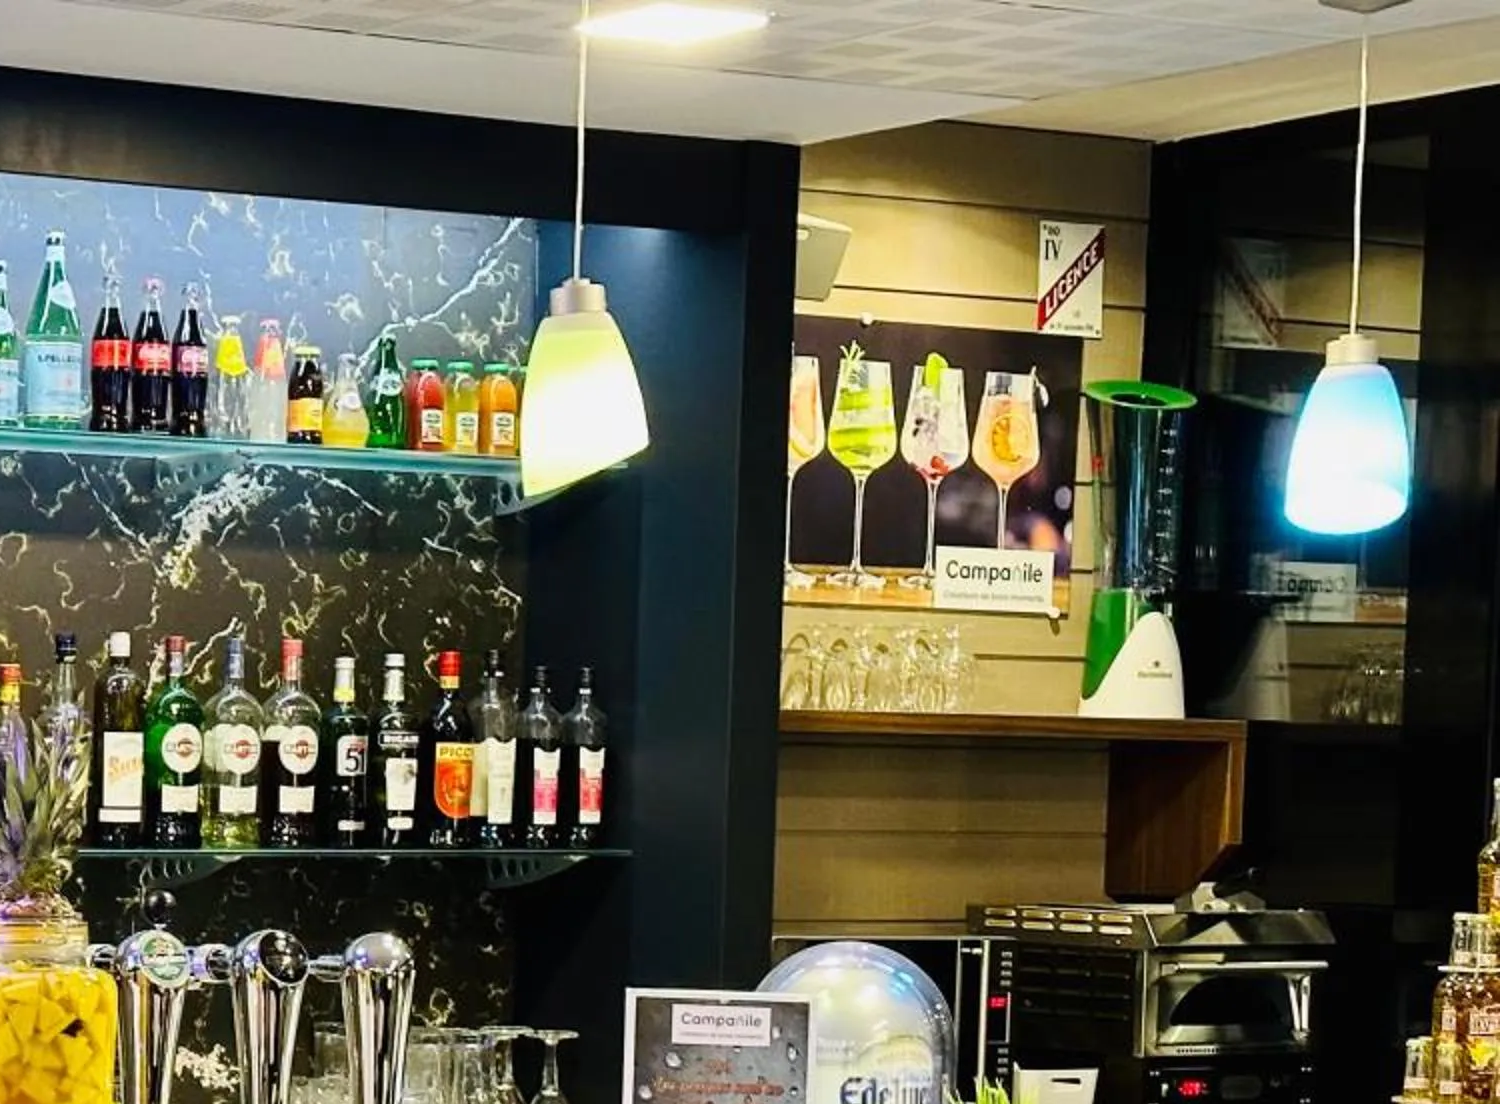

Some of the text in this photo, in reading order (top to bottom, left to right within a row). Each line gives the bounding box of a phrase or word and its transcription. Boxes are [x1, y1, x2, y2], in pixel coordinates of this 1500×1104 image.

[1045, 239, 1100, 319] LICENCE
[946, 559, 1043, 586] Campanile
[681, 1012, 763, 1028] Campanile
